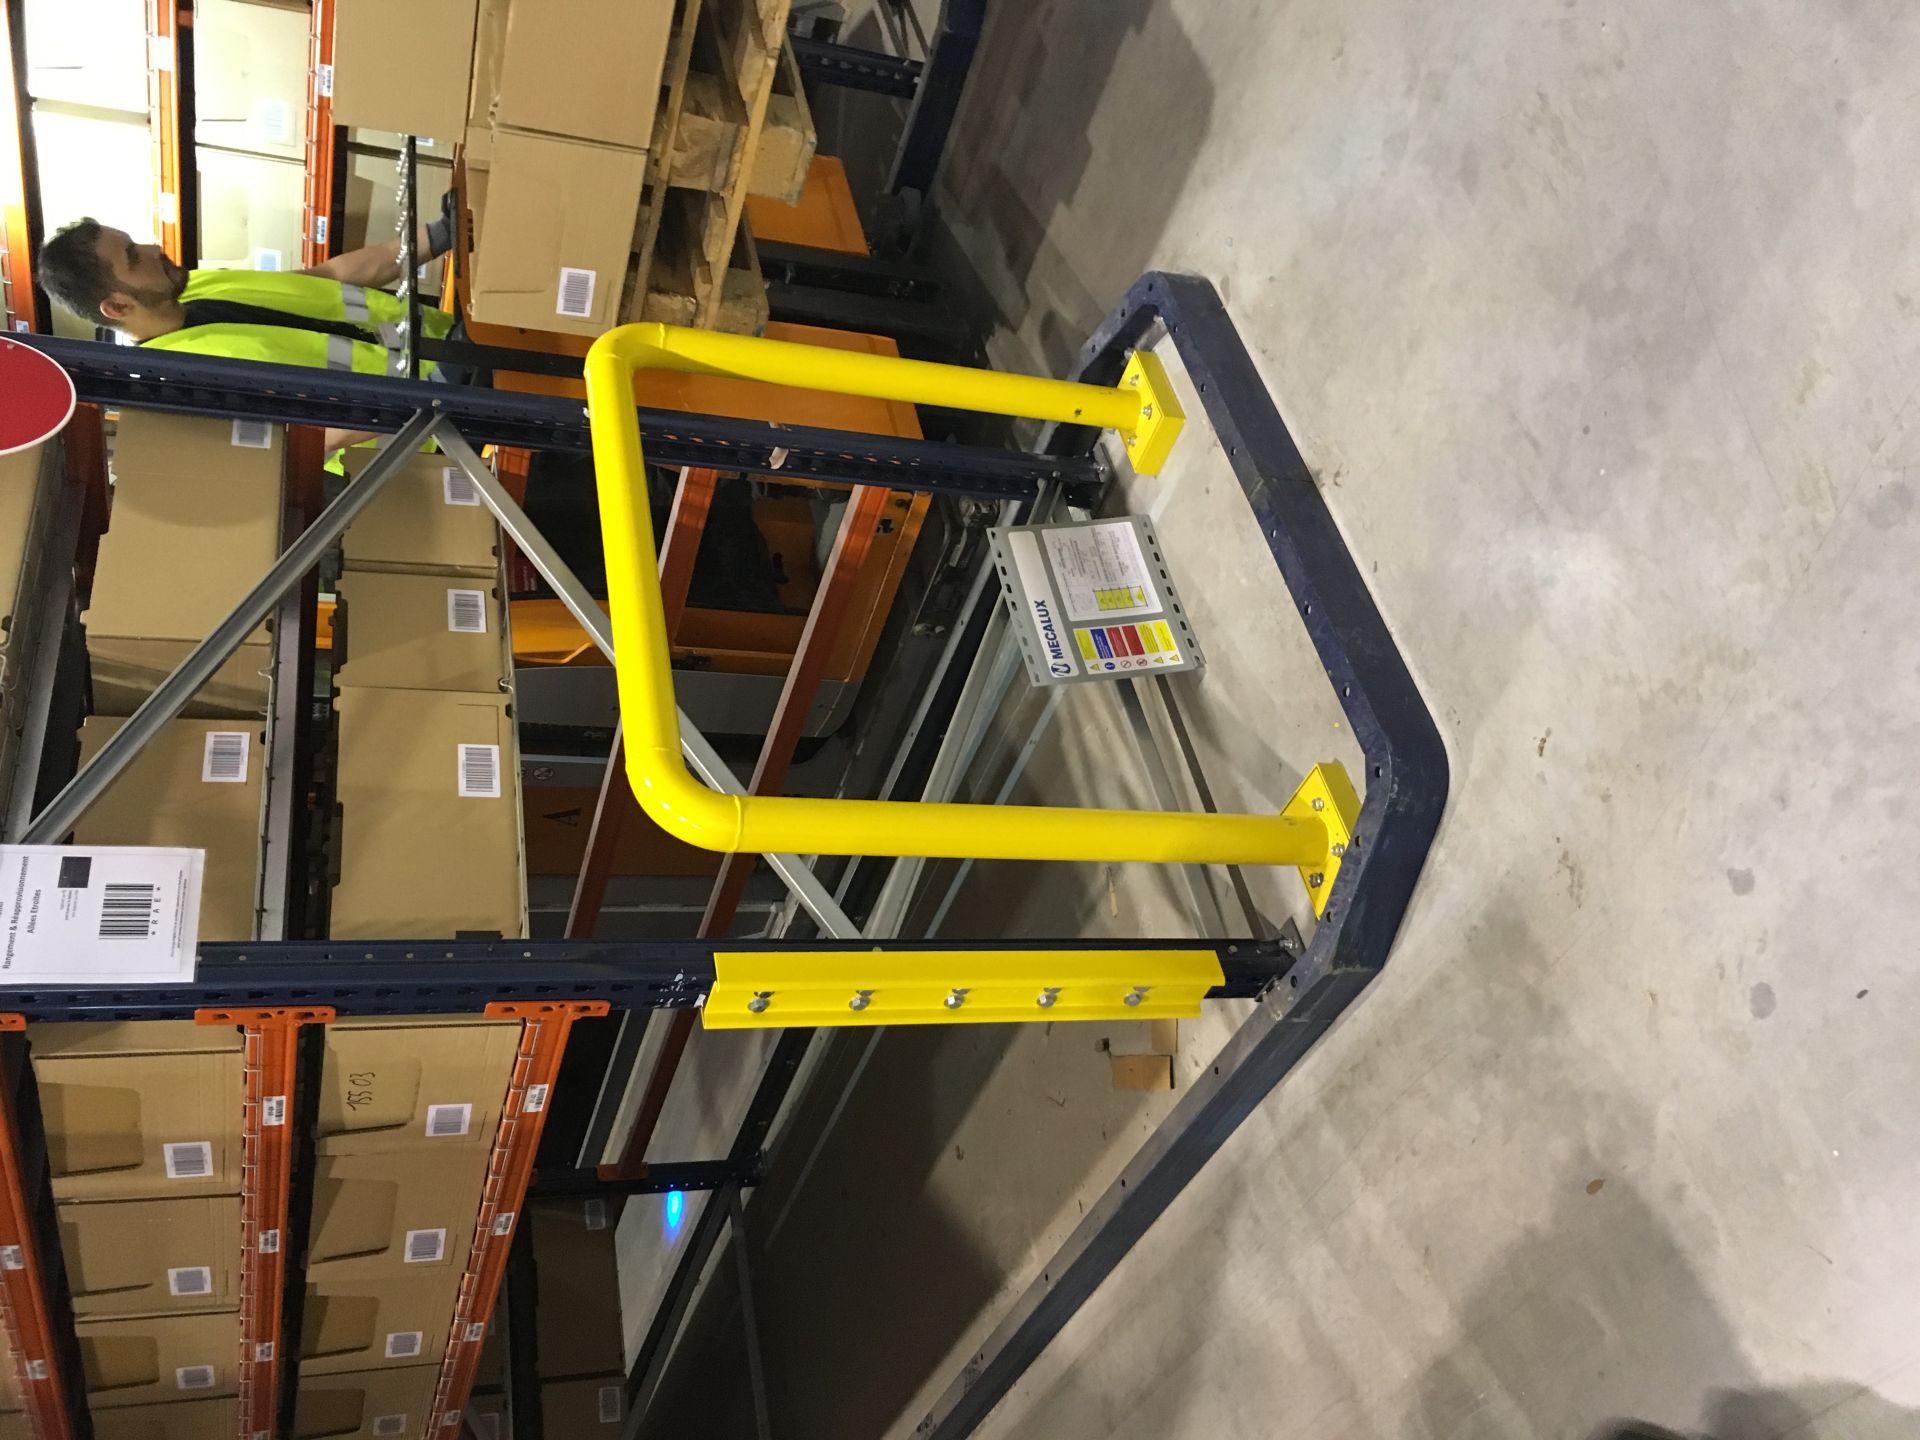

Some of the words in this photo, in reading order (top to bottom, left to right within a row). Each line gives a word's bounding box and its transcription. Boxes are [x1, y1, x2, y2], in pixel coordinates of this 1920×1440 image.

[1034, 599, 1064, 660] MECALUX
[541, 808, 581, 827] A
[2, 932, 16, 969] Rangement
[10, 856, 29, 924] Réapprovisionnement
[30, 889, 41, 914] Etroites
[26, 914, 37, 934] Allées
